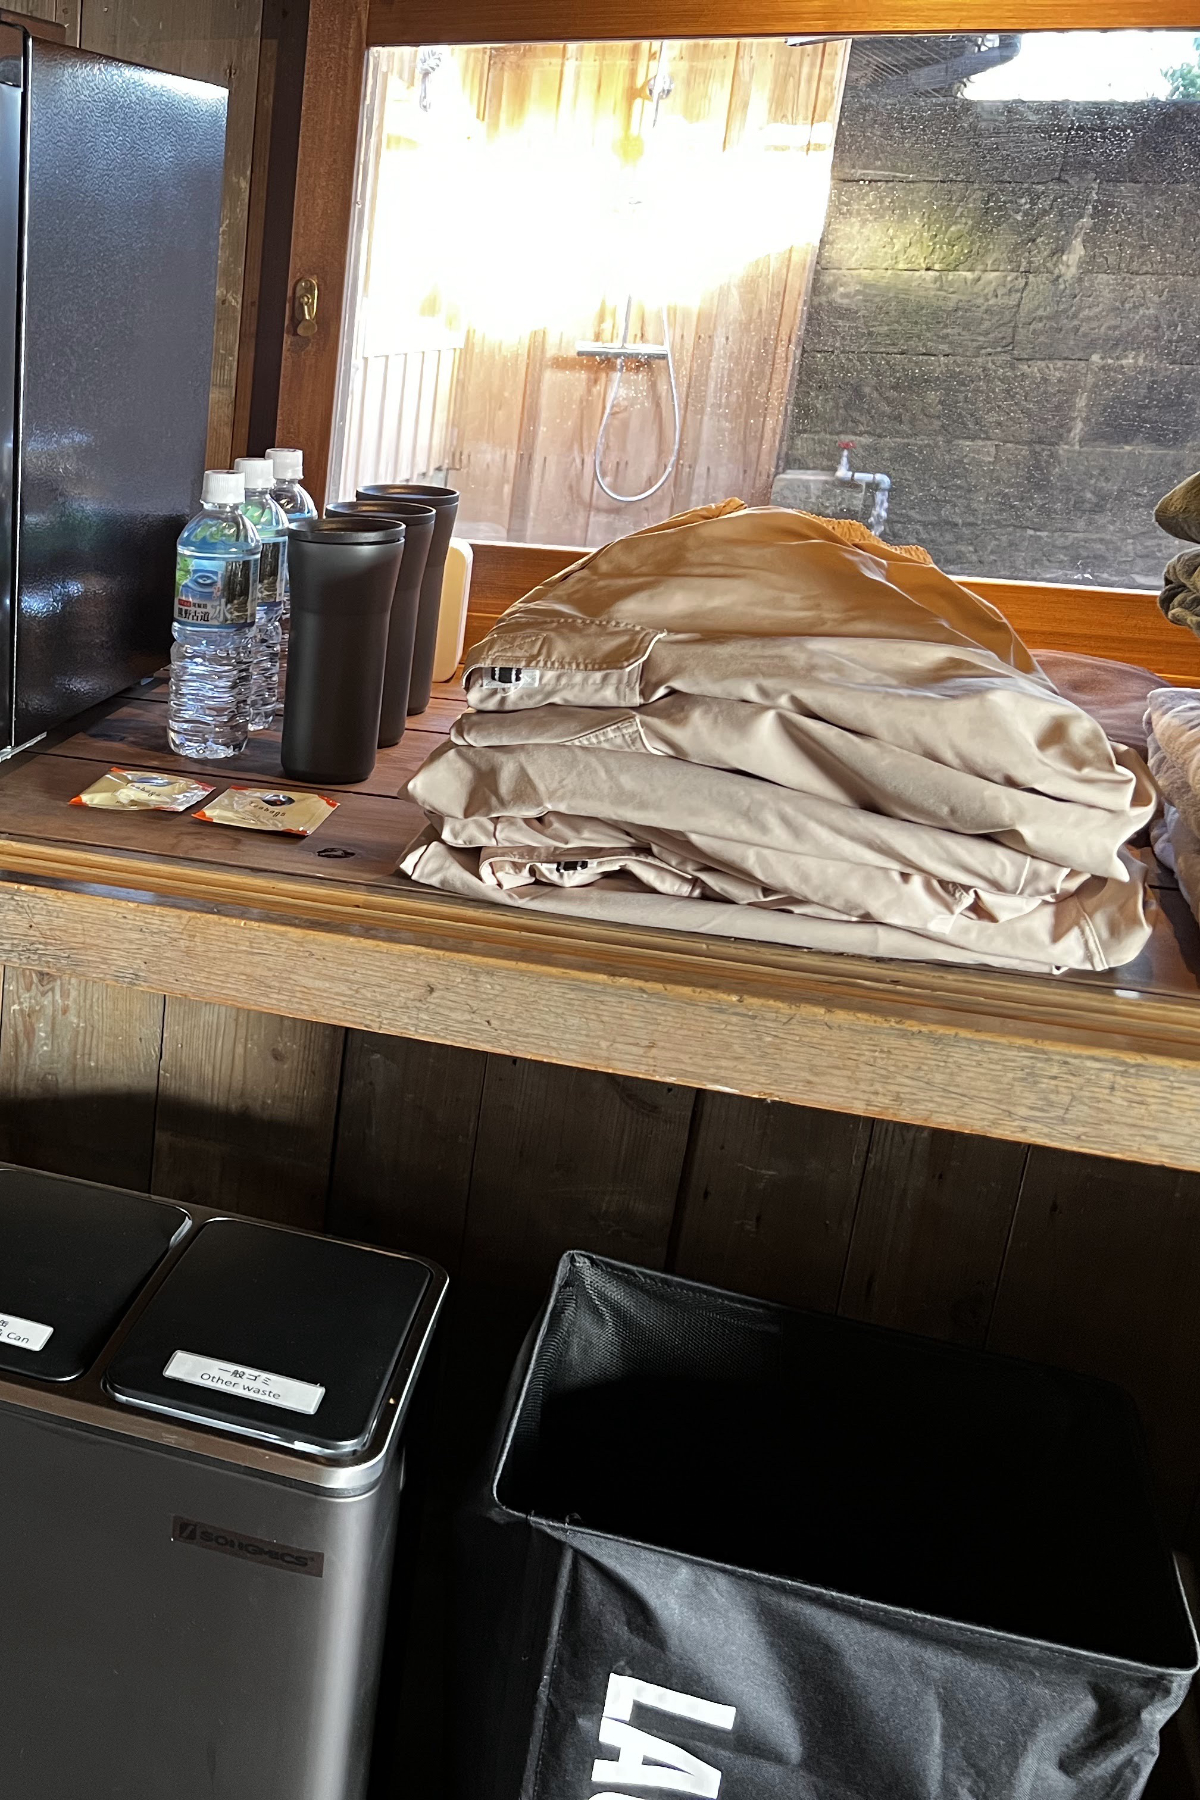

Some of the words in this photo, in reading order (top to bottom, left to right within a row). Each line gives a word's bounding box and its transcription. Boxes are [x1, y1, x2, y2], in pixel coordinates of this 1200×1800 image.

[6, 1332, 30, 1344] Can
[200, 1372, 240, 1389] Other
[242, 1385, 282, 1400] waste
[218, 1367, 272, 1386] 一般ゴミ
[587, 1672, 737, 1800] LA
